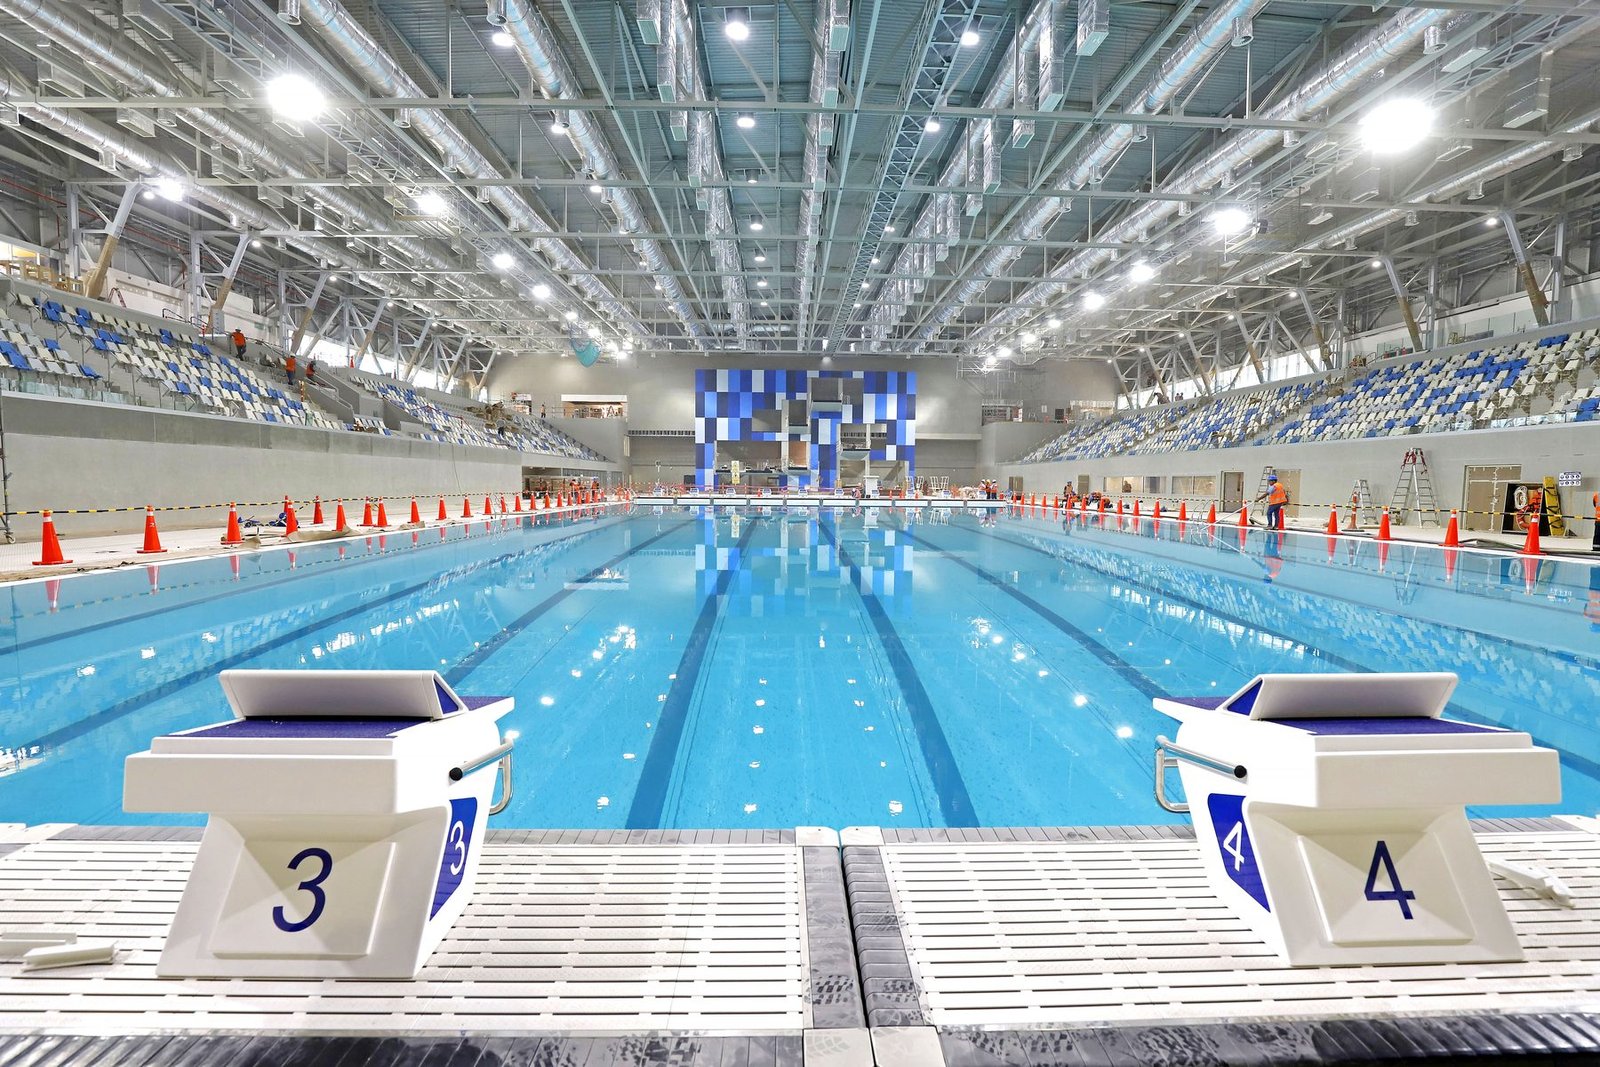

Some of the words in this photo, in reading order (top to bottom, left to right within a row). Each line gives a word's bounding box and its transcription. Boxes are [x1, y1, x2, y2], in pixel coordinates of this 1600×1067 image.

[449, 821, 466, 877] 3
[1222, 820, 1246, 872] 4
[1363, 840, 1416, 920] 4
[272, 847, 334, 933] 3
